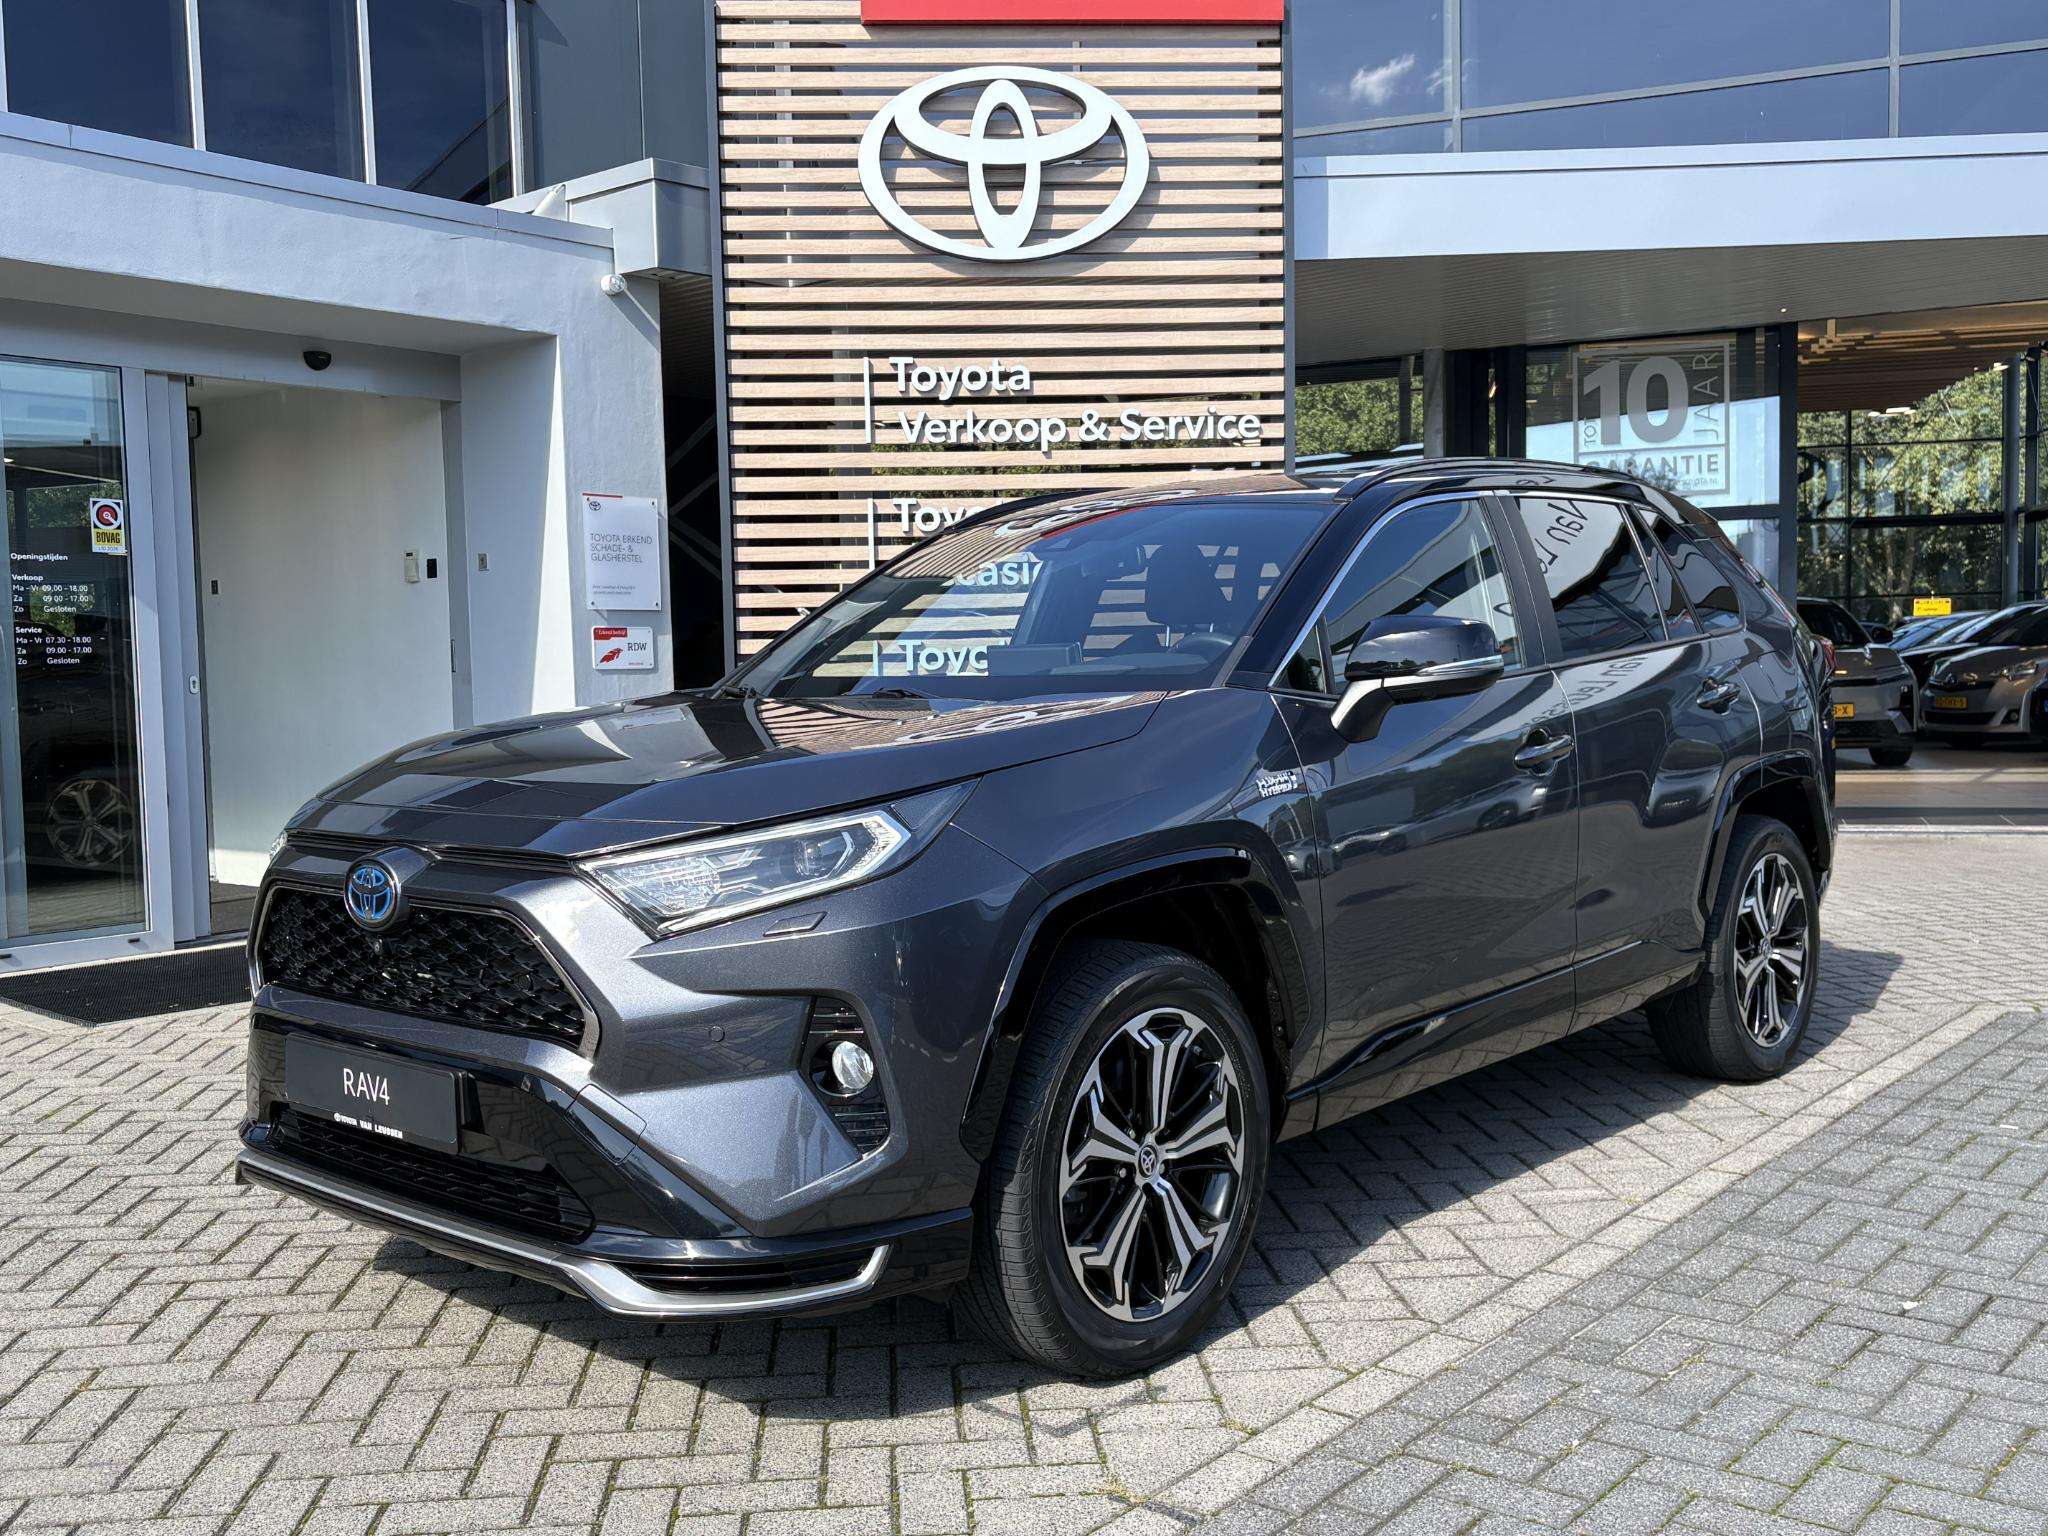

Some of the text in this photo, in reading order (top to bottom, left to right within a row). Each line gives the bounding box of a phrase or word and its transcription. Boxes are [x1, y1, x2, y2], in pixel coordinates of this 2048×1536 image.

[889, 357, 1031, 399] Toyota
[1583, 356, 1689, 445] 10
[1692, 352, 1719, 441] JAAR
[899, 406, 1261, 452] Verkoop & Service
[1586, 454, 1719, 478] ARANTIE
[96, 531, 121, 545] BOVAG
[590, 533, 653, 545] TOYOTA ERKEND
[10, 552, 69, 562] Openingstijden
[590, 552, 643, 563] GLASHERSTEL
[11, 574, 44, 583] Verkoop
[12, 584, 24, 592] Ma
[69, 584, 88, 592] 18.00
[13, 594, 23, 602] Za
[14, 605, 77, 614] Zo Gesloten
[15, 626, 43, 634] Service
[72, 636, 92, 644] 18.00
[17, 647, 27, 655] Za
[46, 647, 67, 655] 09.00
[627, 642, 648, 652] RDW
[17, 657, 80, 665] Zo Gesloten
[343, 1068, 391, 1105] RAV4
